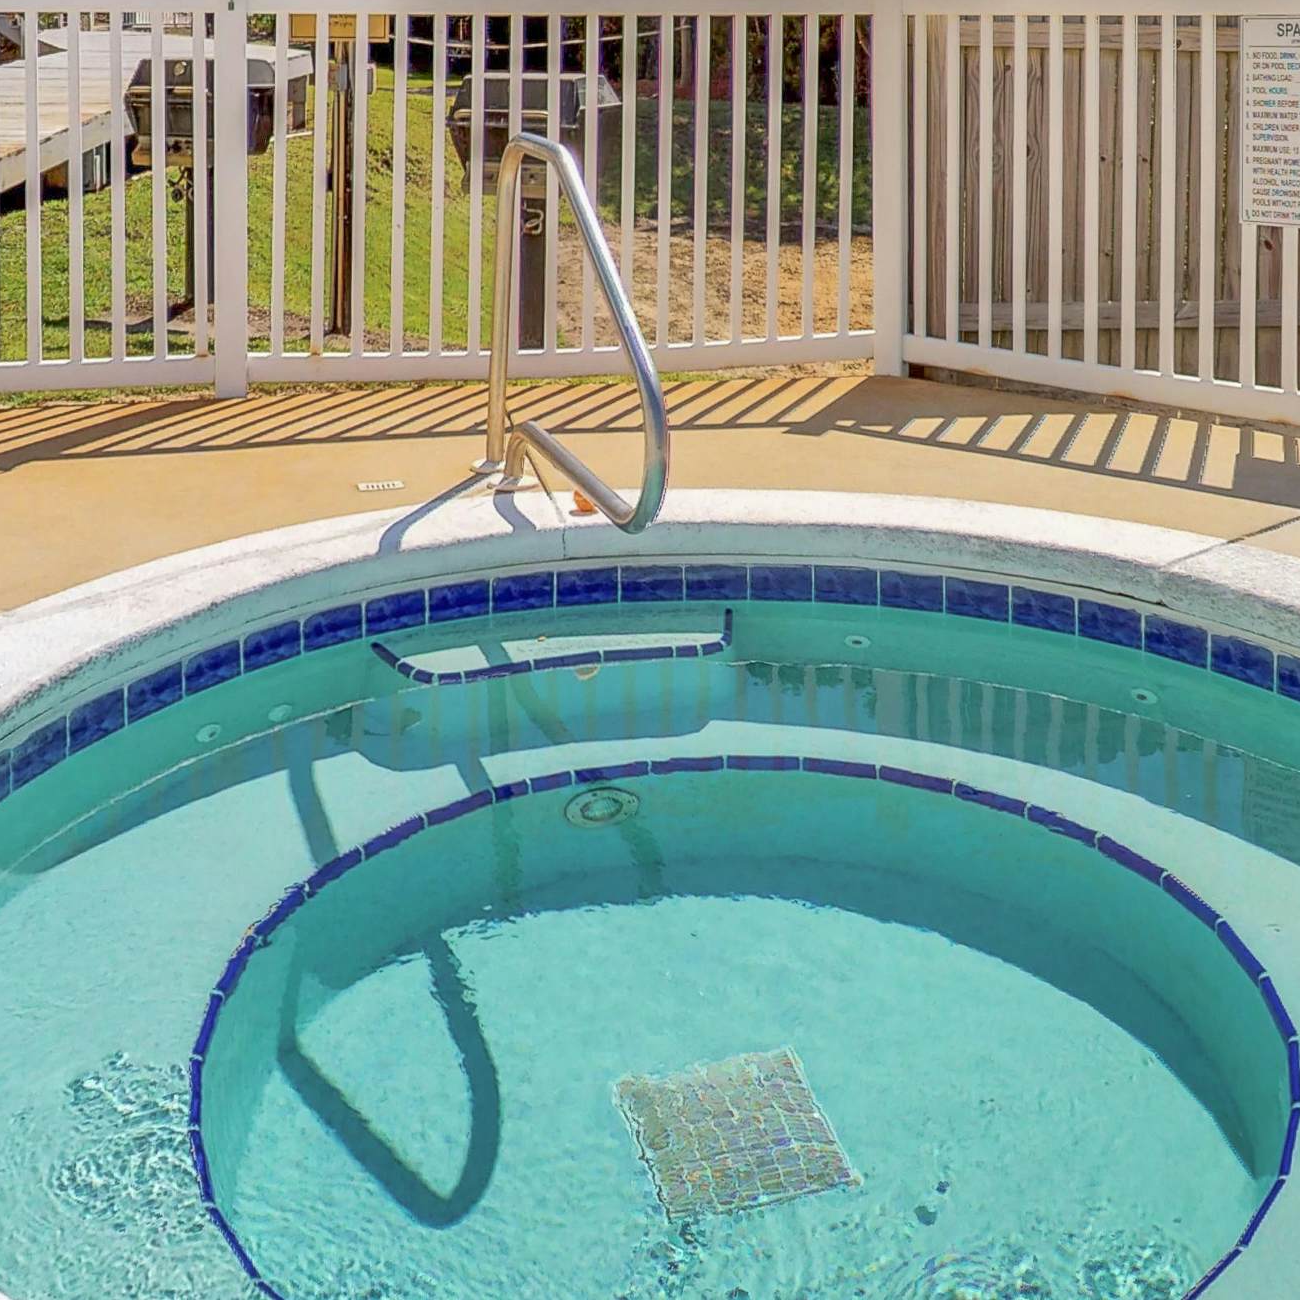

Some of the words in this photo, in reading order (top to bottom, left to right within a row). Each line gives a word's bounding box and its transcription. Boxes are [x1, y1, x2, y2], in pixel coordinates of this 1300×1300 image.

[1252, 52, 1261, 60] NO
[1277, 100, 1300, 108] BEFORE
[1252, 123, 1279, 131] CHILDREN
[1280, 124, 1299, 132] UNDER
[1252, 156, 1282, 165] PREGNANT
[1267, 168, 1288, 176] HEALTH
[1252, 188, 1270, 196] CAUSE
[1252, 198, 1270, 206] POOLS
[1271, 199, 1297, 208] WITHOUT
[1273, 211, 1290, 219] DRINK
